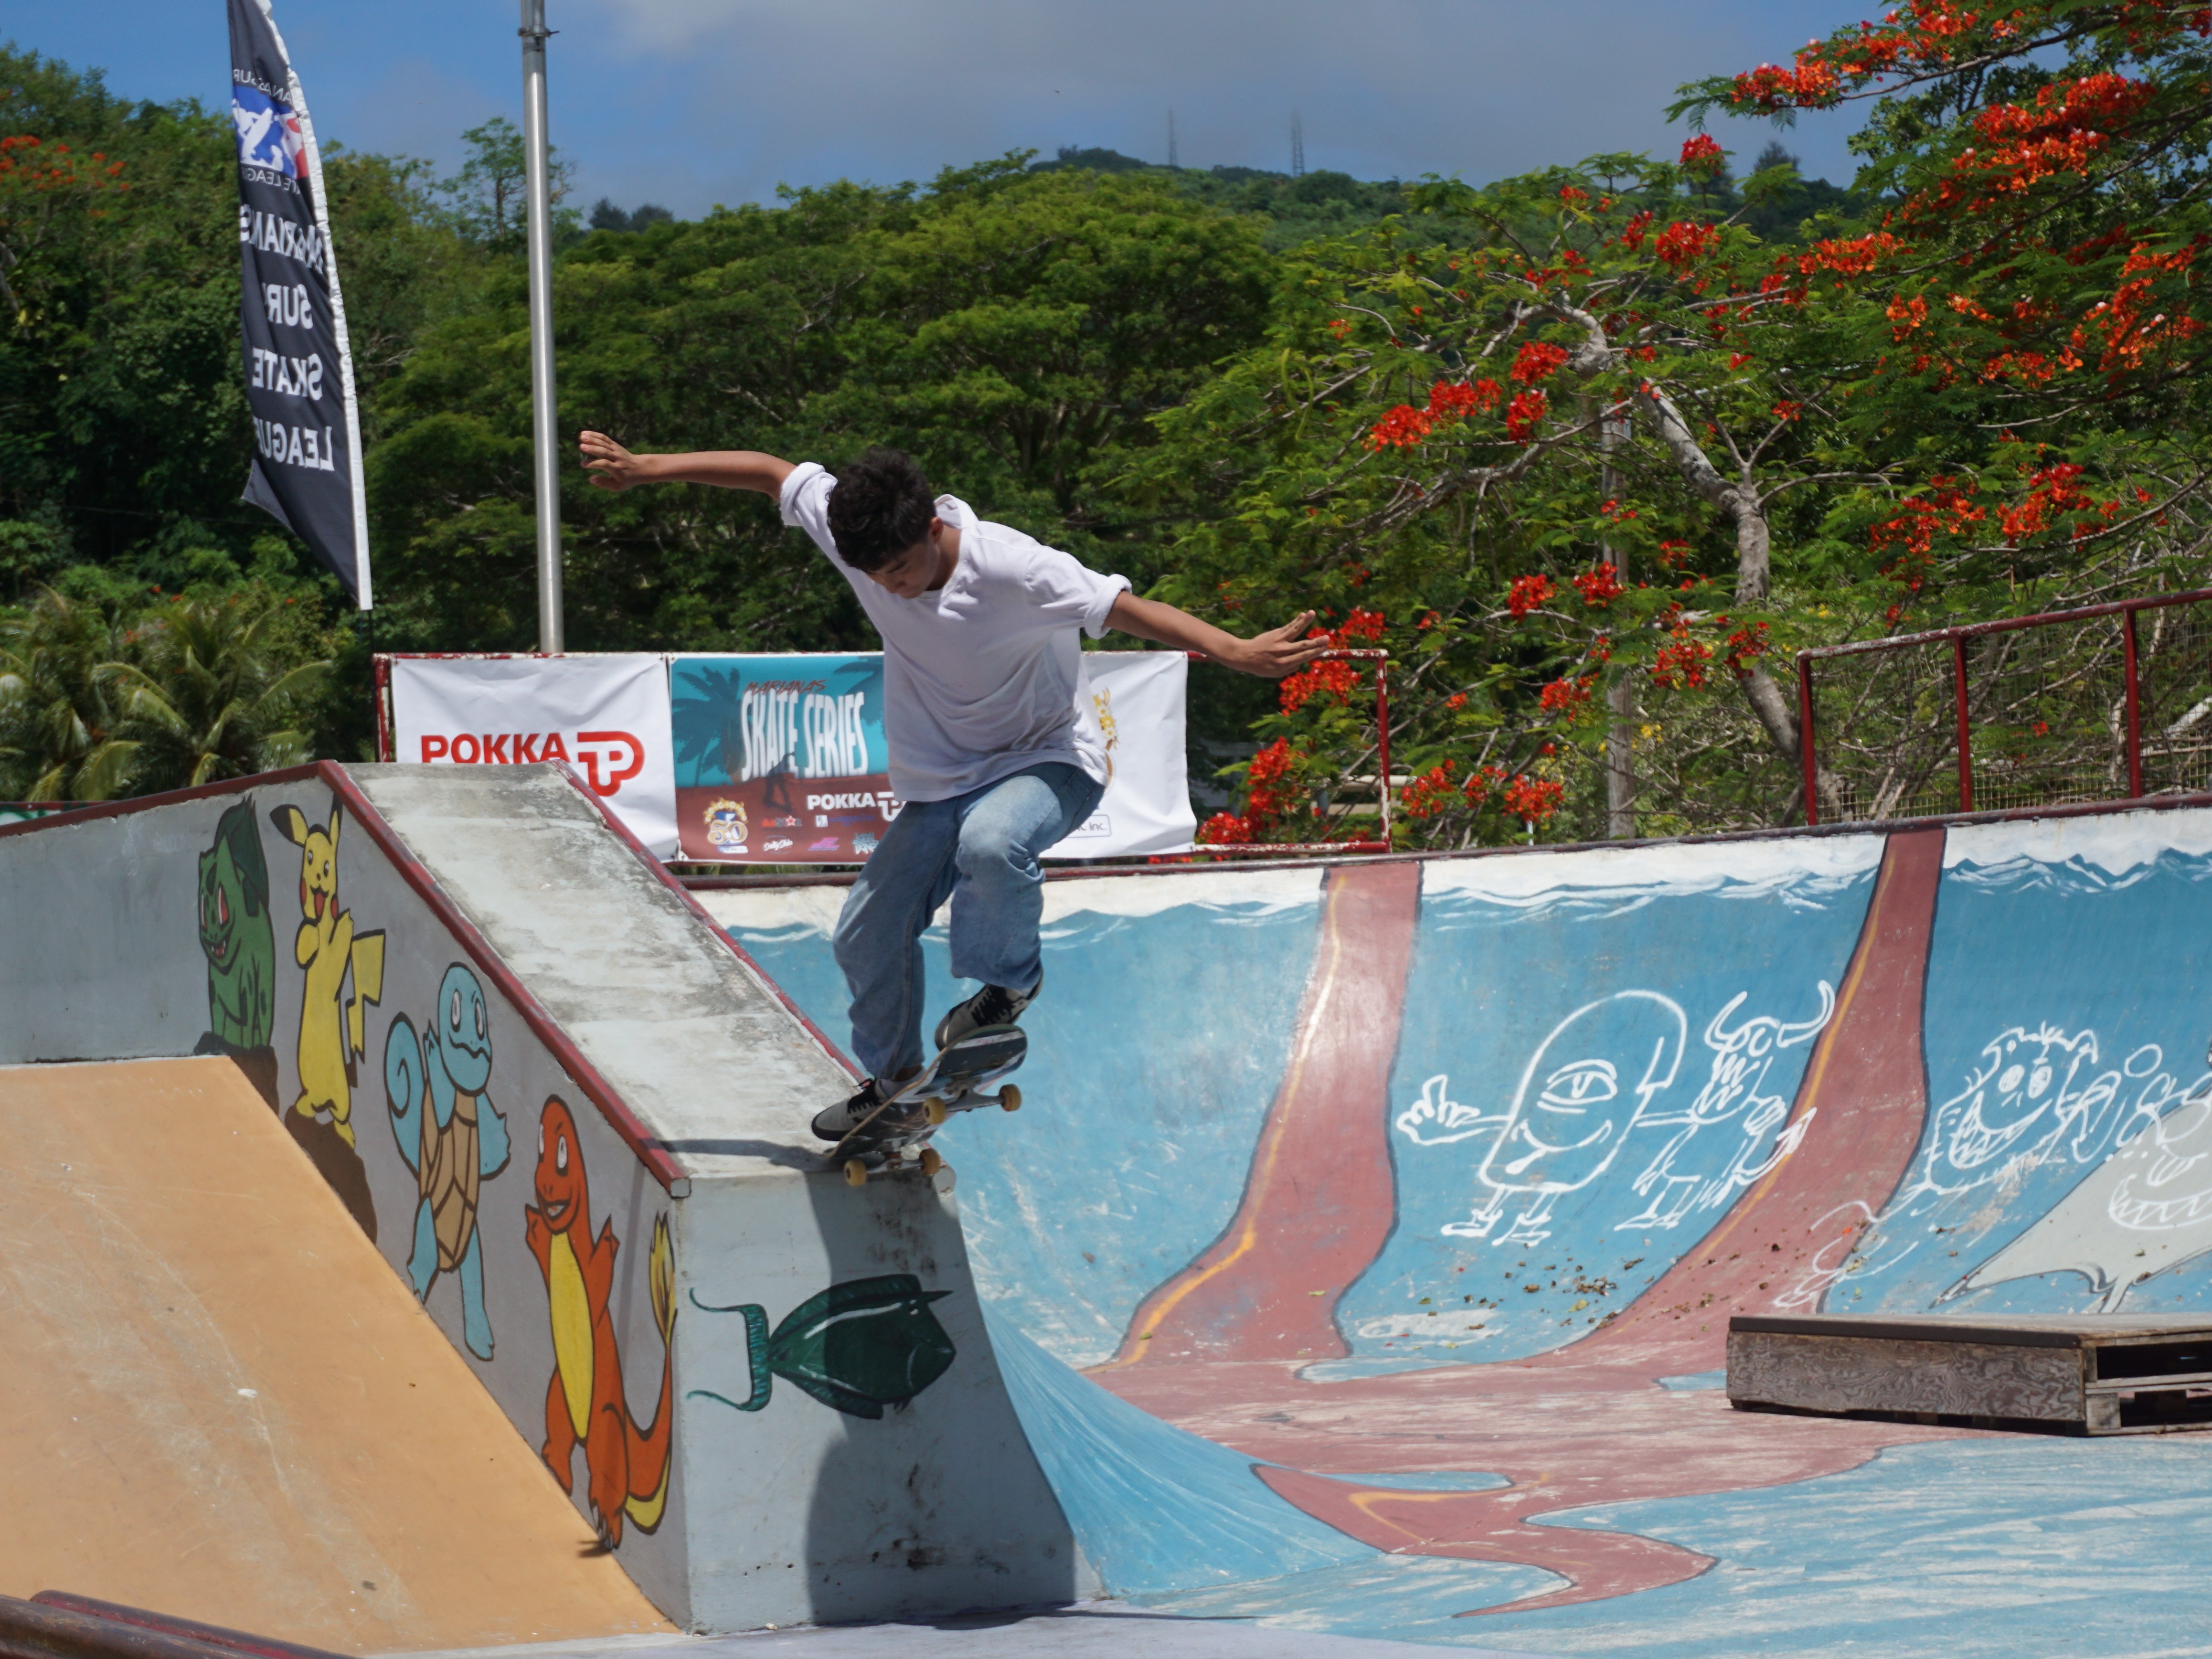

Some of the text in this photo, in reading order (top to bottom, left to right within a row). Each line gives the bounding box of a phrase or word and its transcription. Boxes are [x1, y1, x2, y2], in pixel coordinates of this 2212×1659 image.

[744, 679, 828, 696] MARIANAS
[741, 687, 868, 782] SKATE SERIES
[421, 732, 572, 764] POKKA
[808, 792, 876, 810] POKKA
[707, 819, 748, 845] 50
